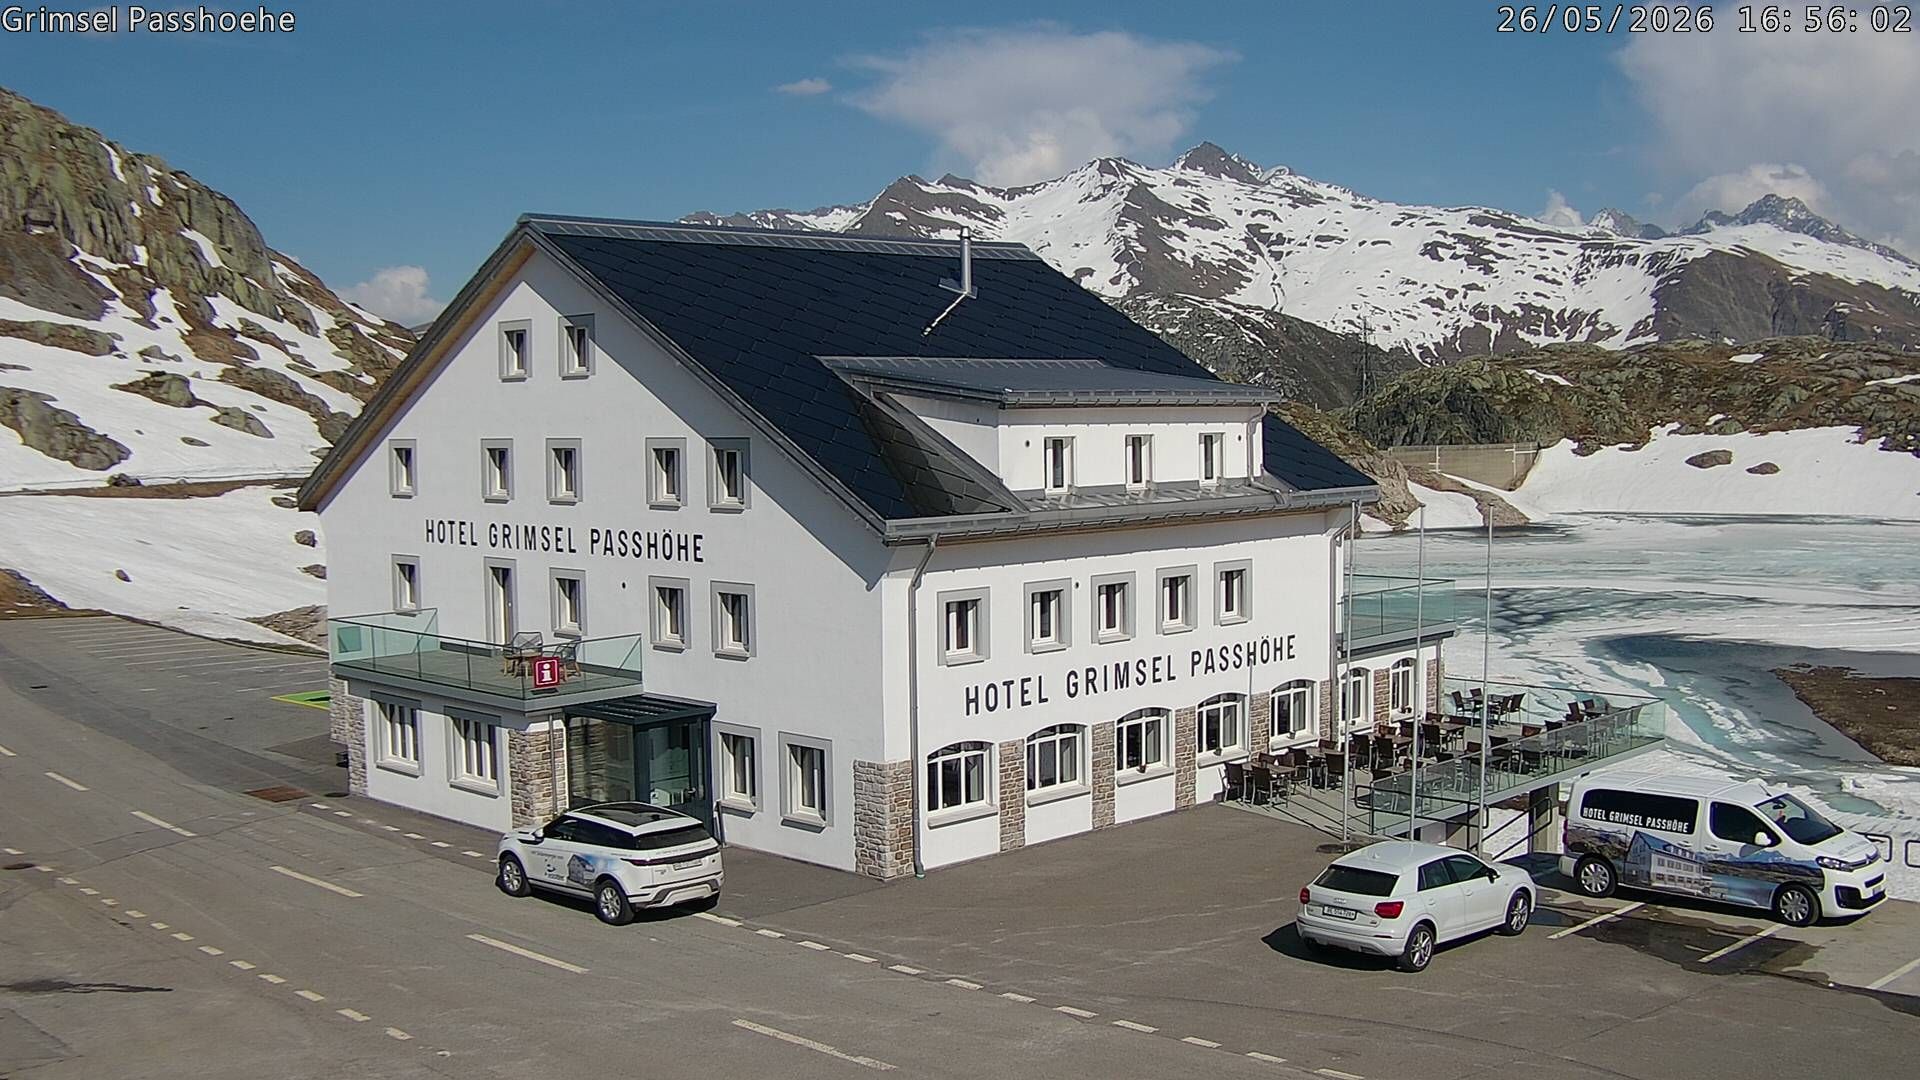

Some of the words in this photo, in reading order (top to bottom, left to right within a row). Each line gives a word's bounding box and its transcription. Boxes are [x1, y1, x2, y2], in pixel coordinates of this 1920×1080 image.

[425, 519, 478, 547] HOTEL
[489, 523, 577, 554] GRIMSEL
[590, 528, 704, 563] PASSHÖHE
[965, 675, 1049, 716] HOTEL
[1066, 655, 1176, 699] GRIMSEL
[1191, 634, 1296, 677] PASSHÖHE
[1582, 807, 1606, 820] HOTEL
[1608, 811, 1643, 826] GRIMSEL
[1645, 816, 1689, 833] PASSHÖHE
